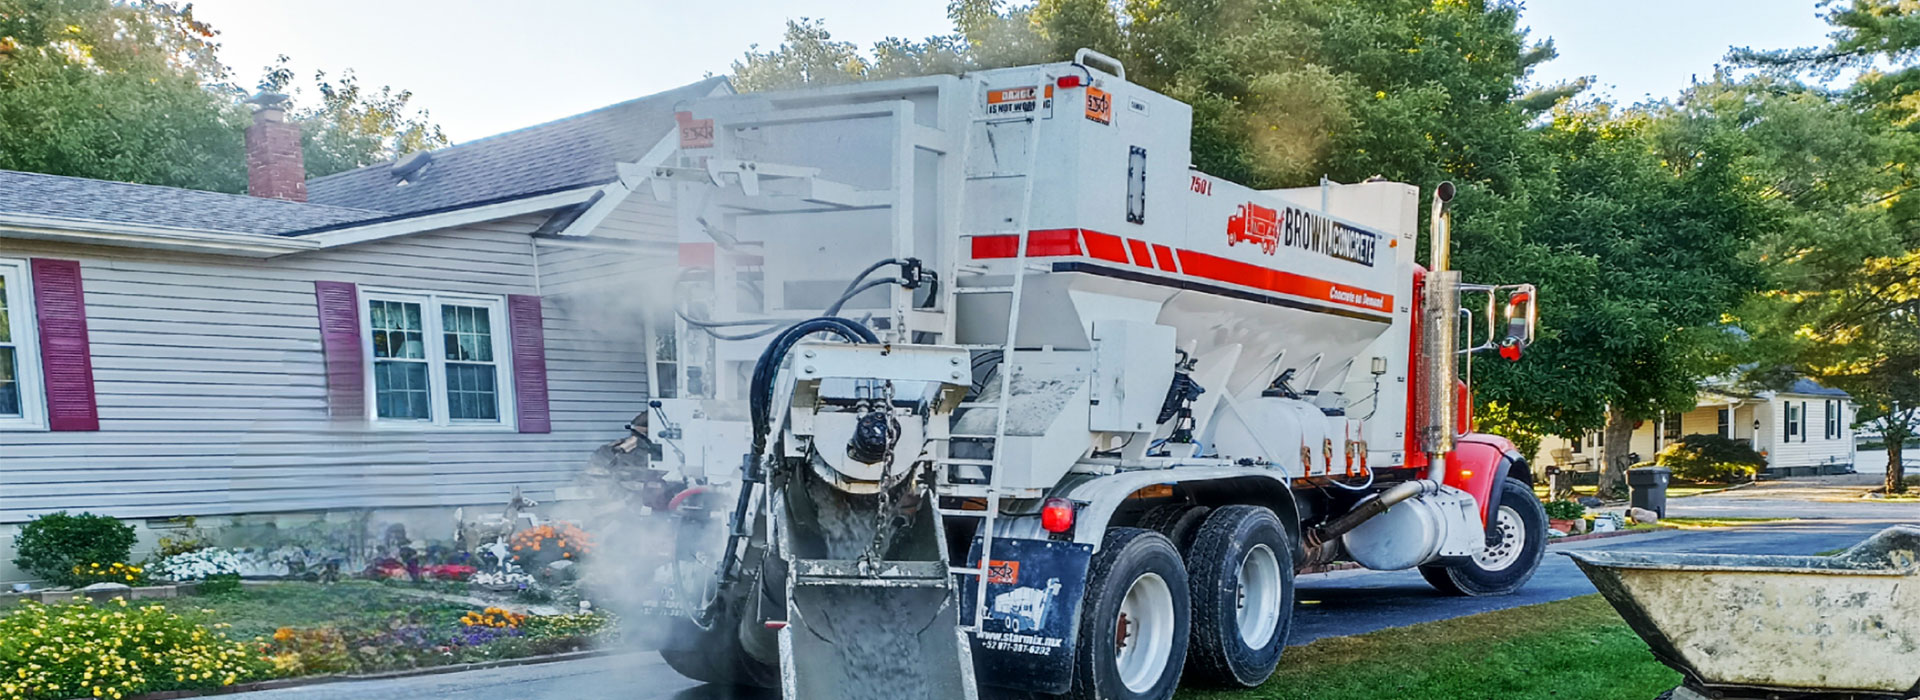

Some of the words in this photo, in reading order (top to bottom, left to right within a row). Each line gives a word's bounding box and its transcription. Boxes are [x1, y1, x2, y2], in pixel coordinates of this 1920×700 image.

[998, 103, 1012, 112] NOT
[1190, 176, 1207, 195] 750
[1285, 207, 1330, 255] BROWN
[1331, 225, 1375, 265] CONCRETE
[976, 631, 1062, 648] www.starmix.mx
